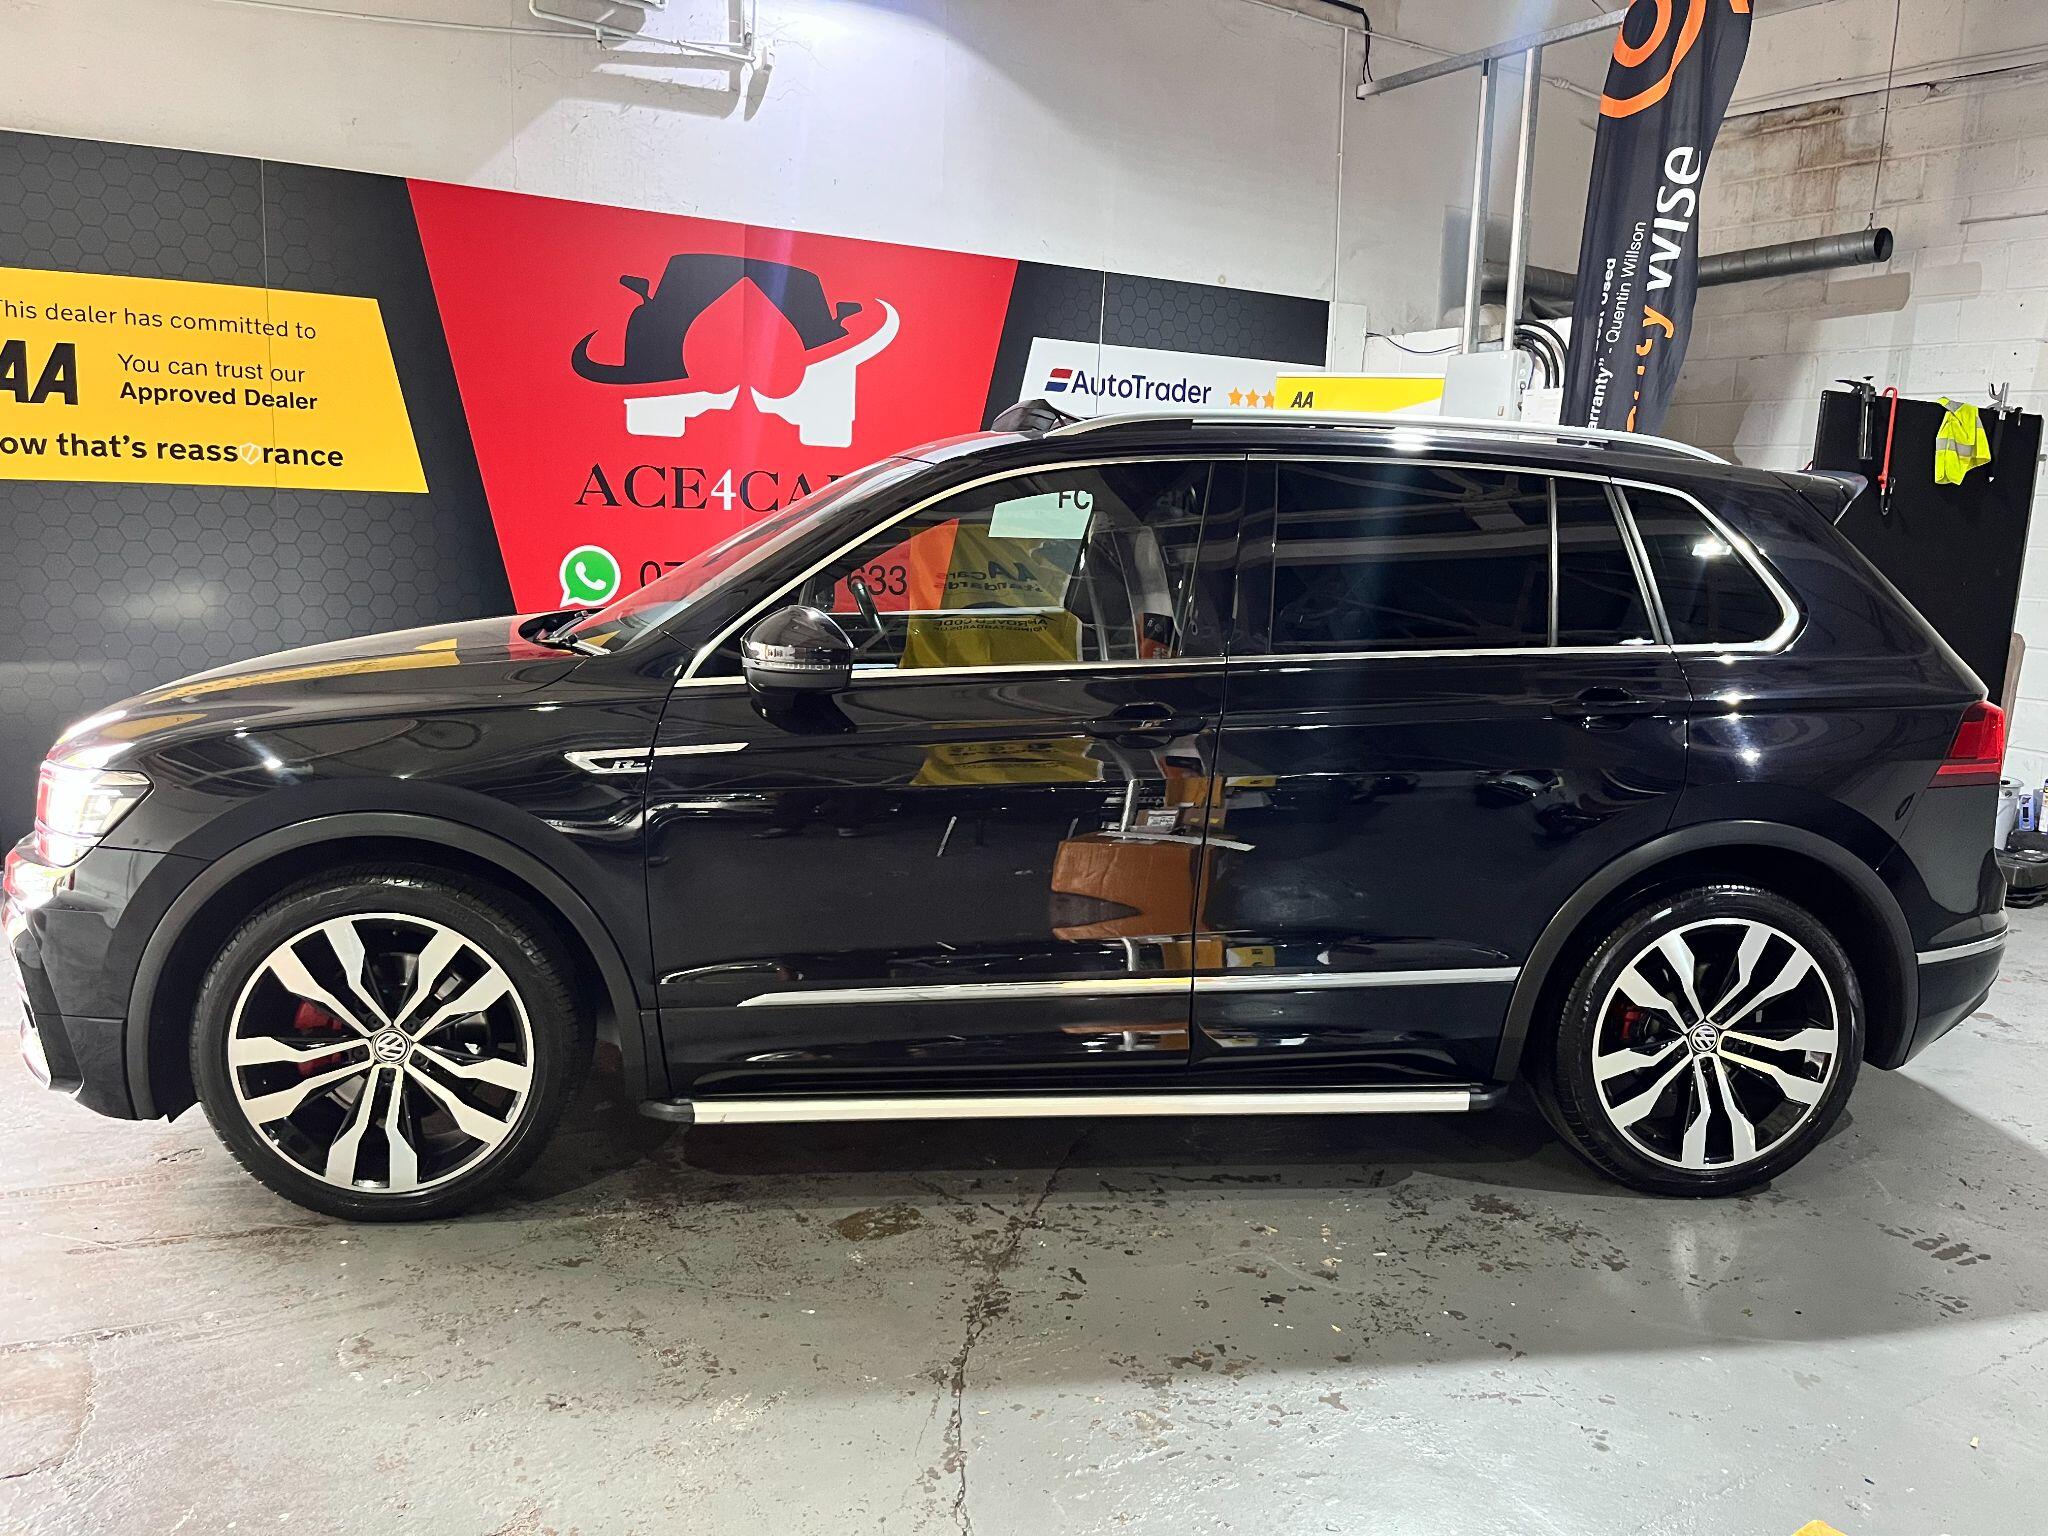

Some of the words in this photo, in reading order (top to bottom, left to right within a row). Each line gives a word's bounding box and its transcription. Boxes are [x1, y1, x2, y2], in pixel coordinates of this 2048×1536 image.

[0, 299, 38, 319] his
[45, 302, 117, 325] dealer
[125, 308, 163, 328] has
[170, 313, 289, 338] committed
[295, 321, 317, 340] to
[1588, 358, 1613, 429] arranty”
[1606, 282, 1632, 343] Quentin
[1621, 221, 1646, 278] Willson
[0, 339, 78, 406] AA
[118, 353, 160, 375] You
[168, 360, 208, 377] can
[215, 361, 264, 380] trust
[271, 366, 306, 383] our
[120, 381, 237, 405] Approved
[245, 388, 318, 411] Dealer
[1071, 369, 1212, 404] AutoTrader
[1290, 391, 1314, 408] AA
[0, 434, 47, 456] ow
[157, 441, 344, 468] reassrance
[575, 462, 846, 512] ACE4CA
